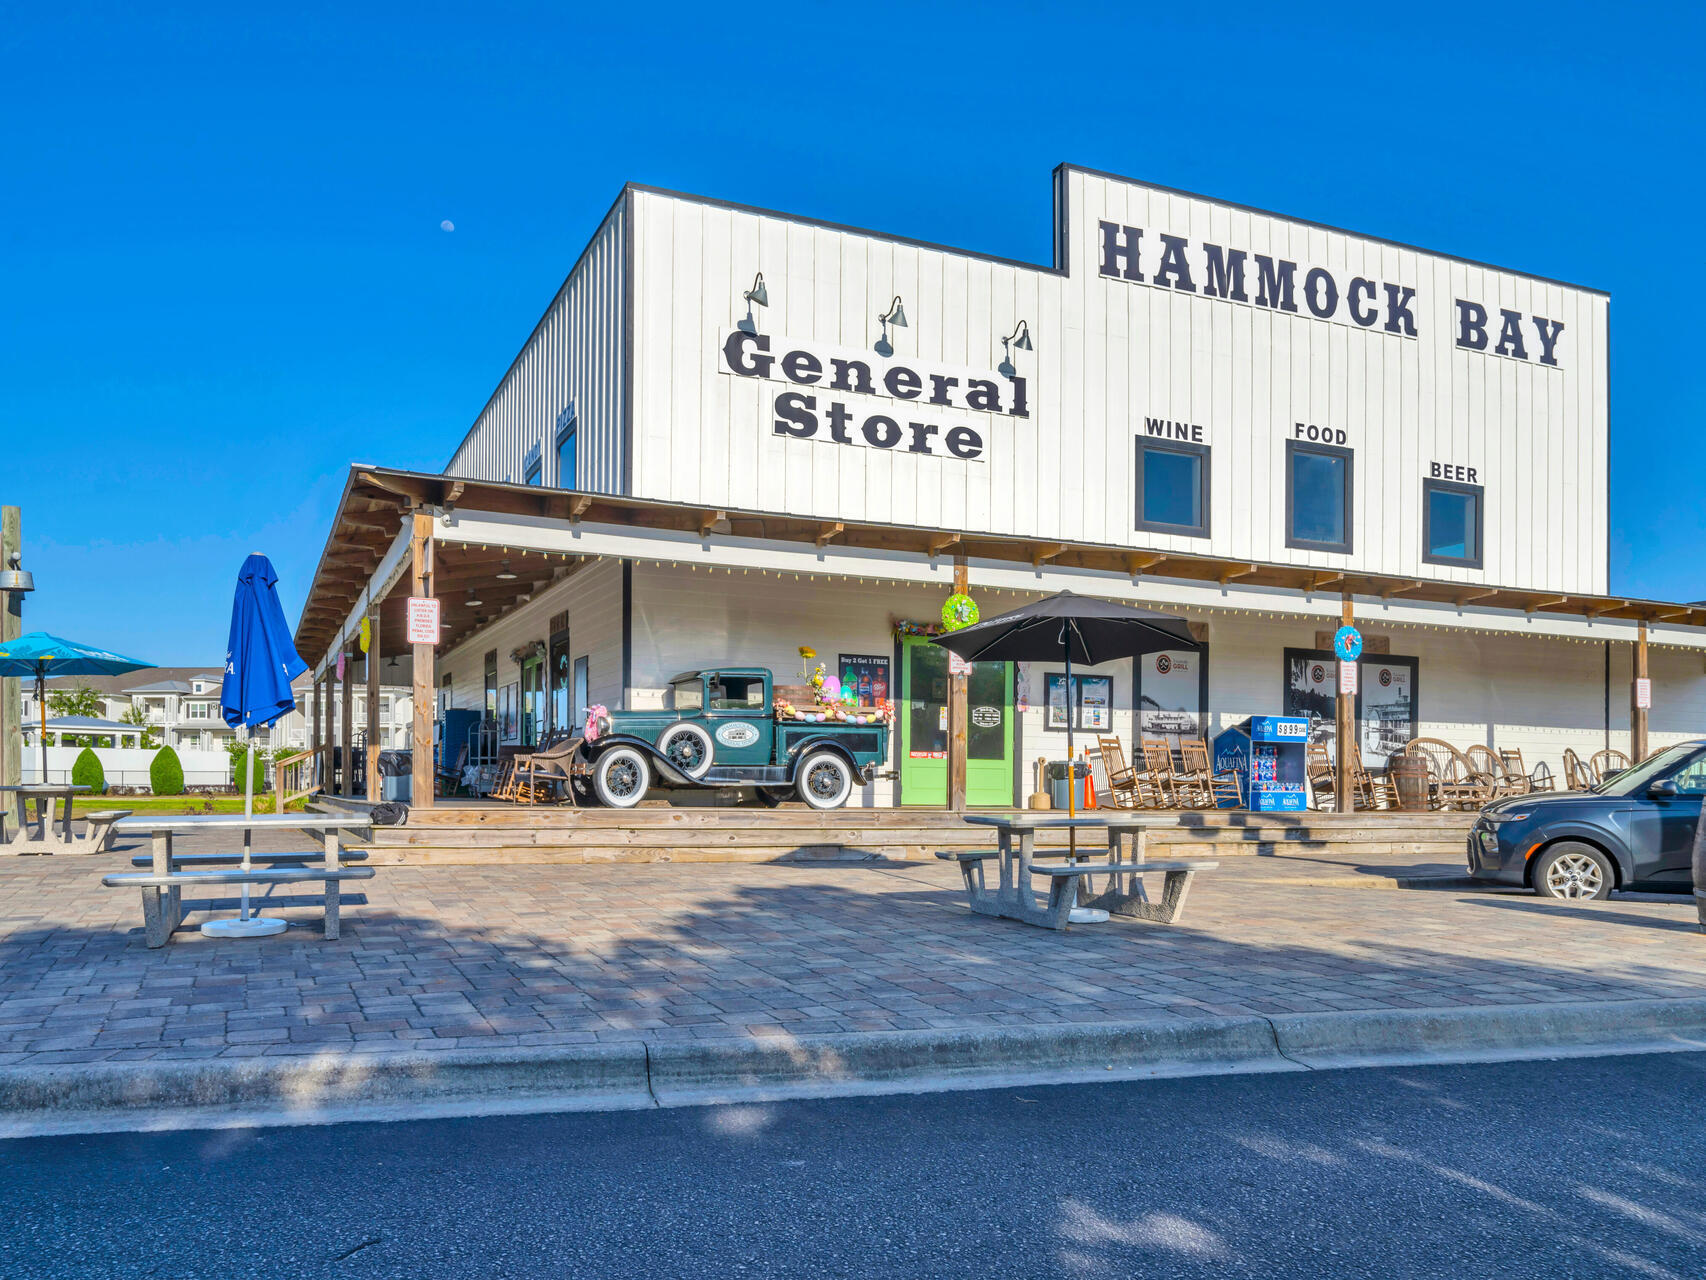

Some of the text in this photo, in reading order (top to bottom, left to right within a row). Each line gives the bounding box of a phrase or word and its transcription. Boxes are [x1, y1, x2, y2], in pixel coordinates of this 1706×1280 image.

[1099, 219, 1565, 366] HAMMOCK BAY
[722, 329, 1030, 417] General
[774, 391, 983, 459] Store
[1146, 417, 1203, 443] WINE
[1295, 422, 1347, 446] FOOD
[1431, 461, 1478, 484] BEER
[840, 656, 851, 664] Buy
[1215, 754, 1249, 772] AQUAFINA
